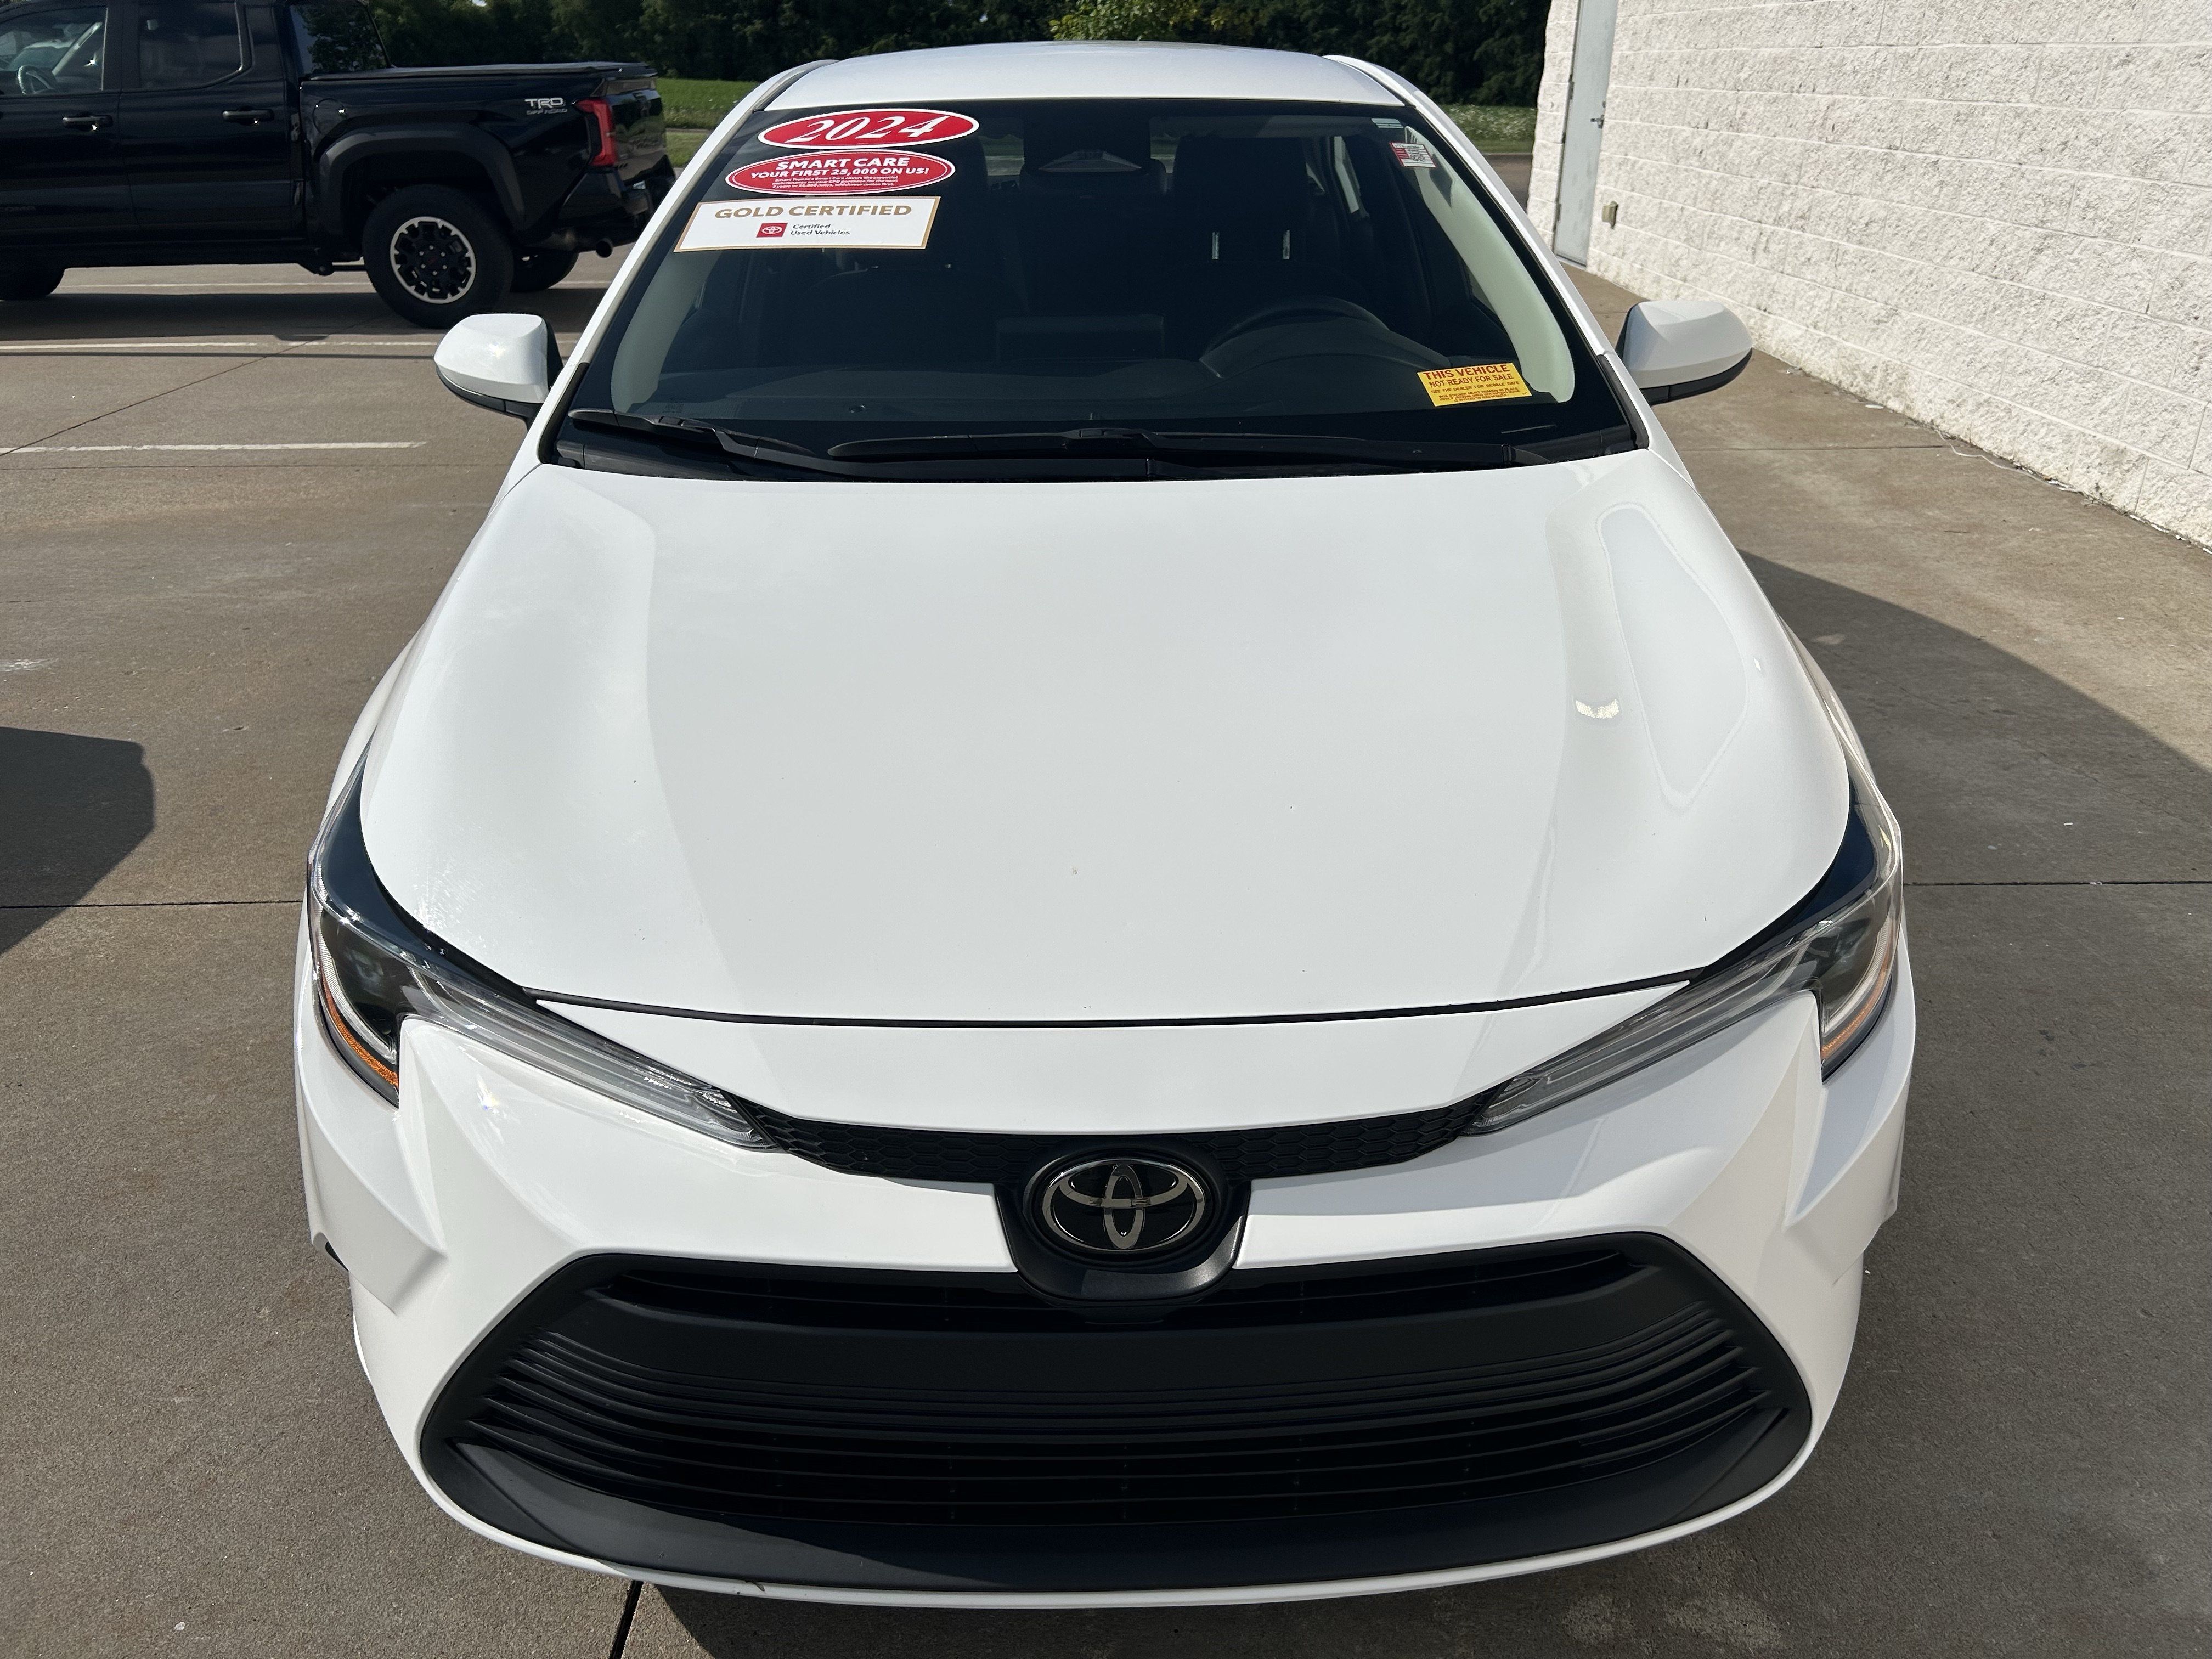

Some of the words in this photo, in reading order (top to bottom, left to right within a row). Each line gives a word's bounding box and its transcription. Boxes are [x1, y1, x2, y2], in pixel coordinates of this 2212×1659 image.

[525, 98, 563, 109] TRD
[784, 115, 951, 143] 2024
[776, 159, 851, 170] SMART
[853, 157, 910, 167] CARE
[751, 171, 789, 179] YOUR
[715, 207, 784, 219] GOLD
[788, 205, 912, 216] CERTIFIED
[1423, 369, 1454, 380] THIS
[1455, 364, 1510, 376] VEHICLE
[1429, 380, 1445, 388] NOT
[1447, 376, 1473, 386] READY
[1475, 375, 1493, 383] FOR
